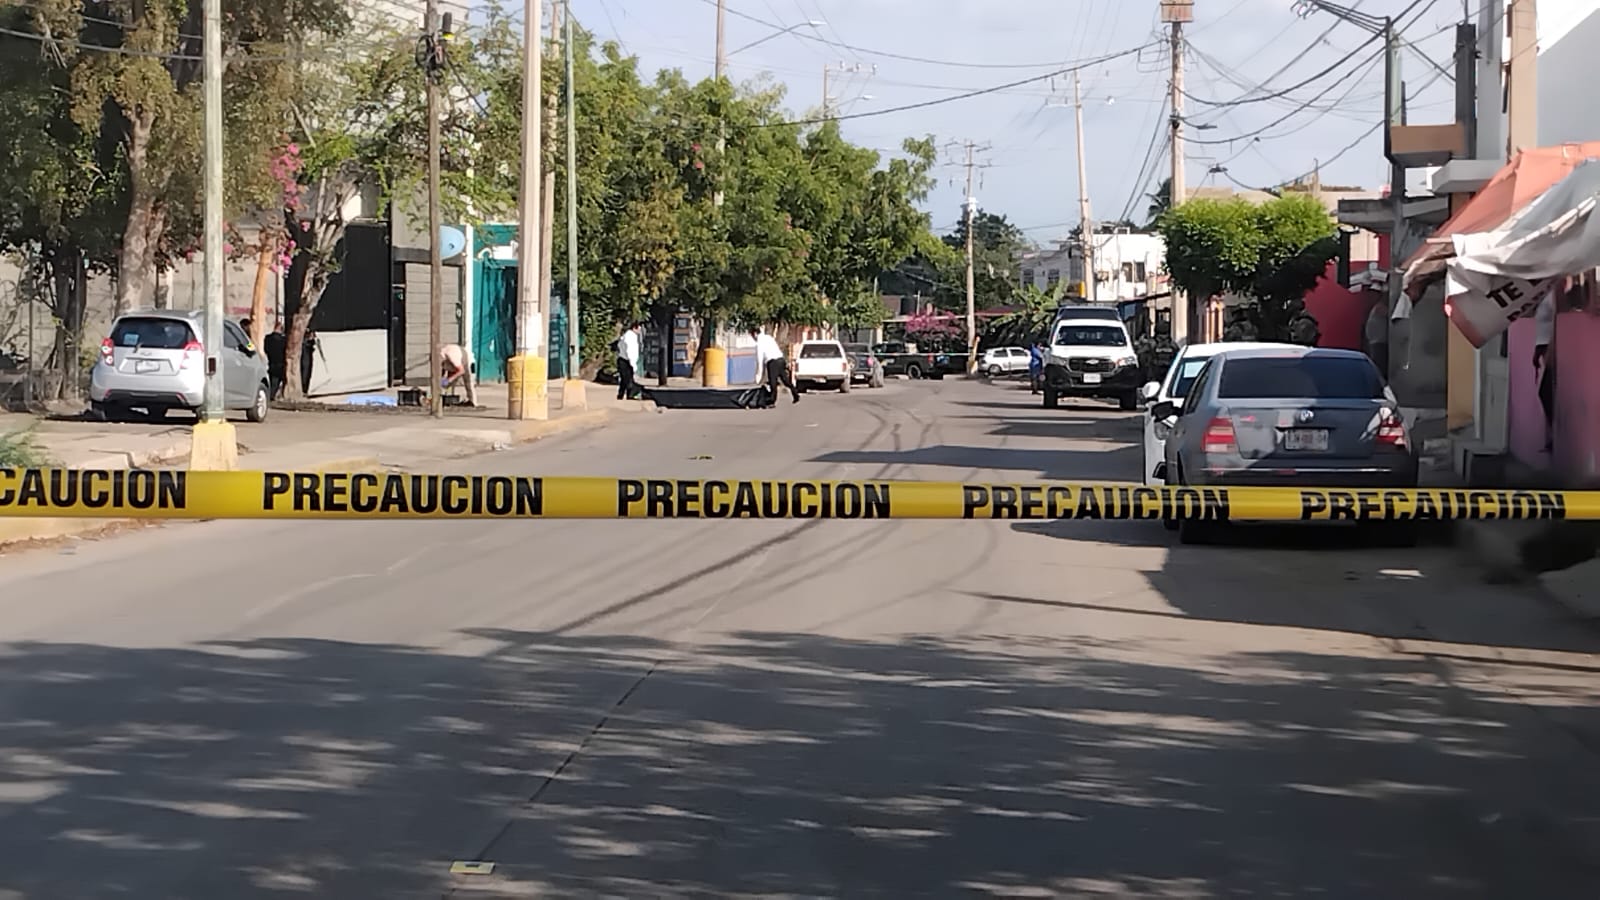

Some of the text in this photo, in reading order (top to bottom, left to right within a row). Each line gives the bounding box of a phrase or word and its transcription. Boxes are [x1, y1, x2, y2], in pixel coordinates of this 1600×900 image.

[1486, 281, 1524, 308] TE
[0, 469, 187, 509] CAUCION
[263, 472, 543, 516] PRECAUCION
[617, 480, 891, 519] PRECAUCION
[963, 485, 1230, 520] PRECAUCION
